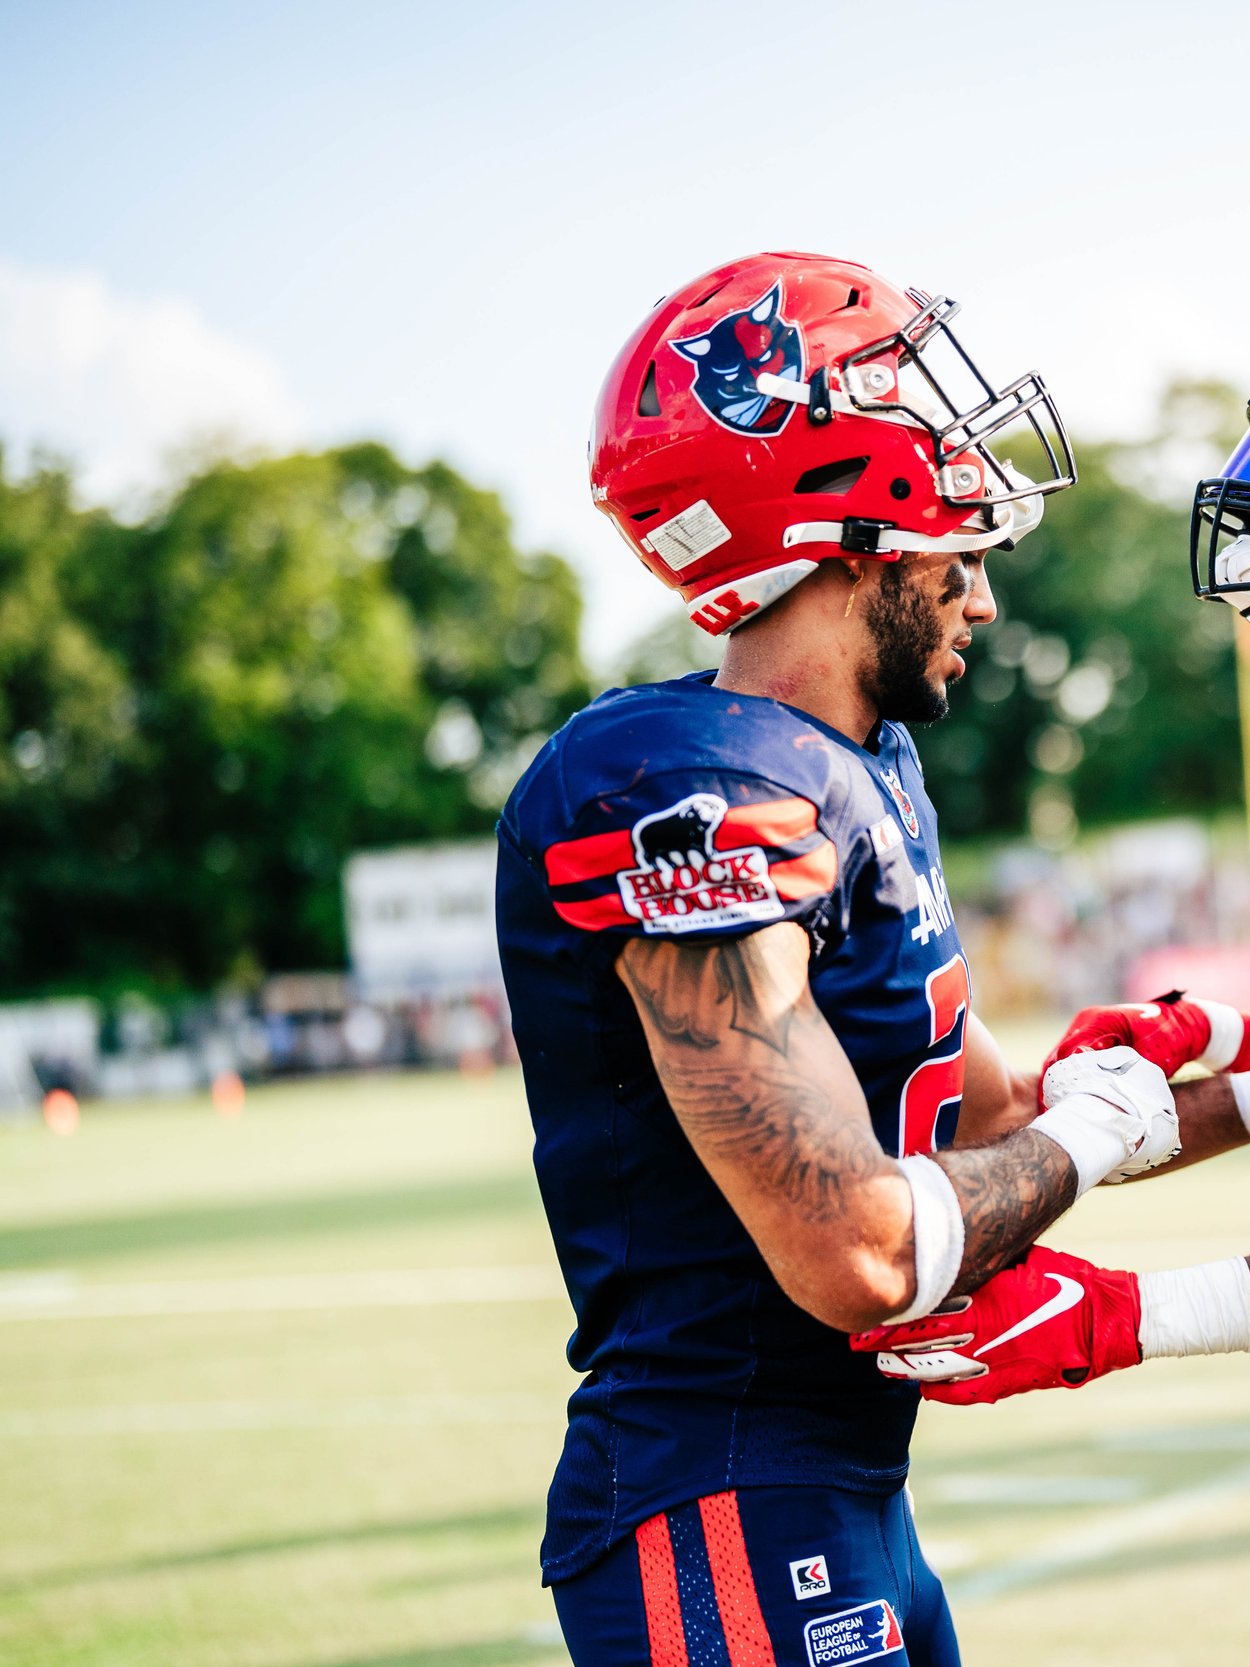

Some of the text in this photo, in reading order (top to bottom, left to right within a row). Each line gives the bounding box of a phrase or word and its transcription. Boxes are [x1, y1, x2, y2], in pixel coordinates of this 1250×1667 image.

[626, 853, 759, 899] BLOCK
[638, 882, 770, 921] HOUSE
[800, 1580, 826, 1592] PRO
[811, 1616, 864, 1641] EUROPEAN
[813, 1631, 853, 1652] LEAGUE
[815, 1639, 869, 1664] FOOTBALL
